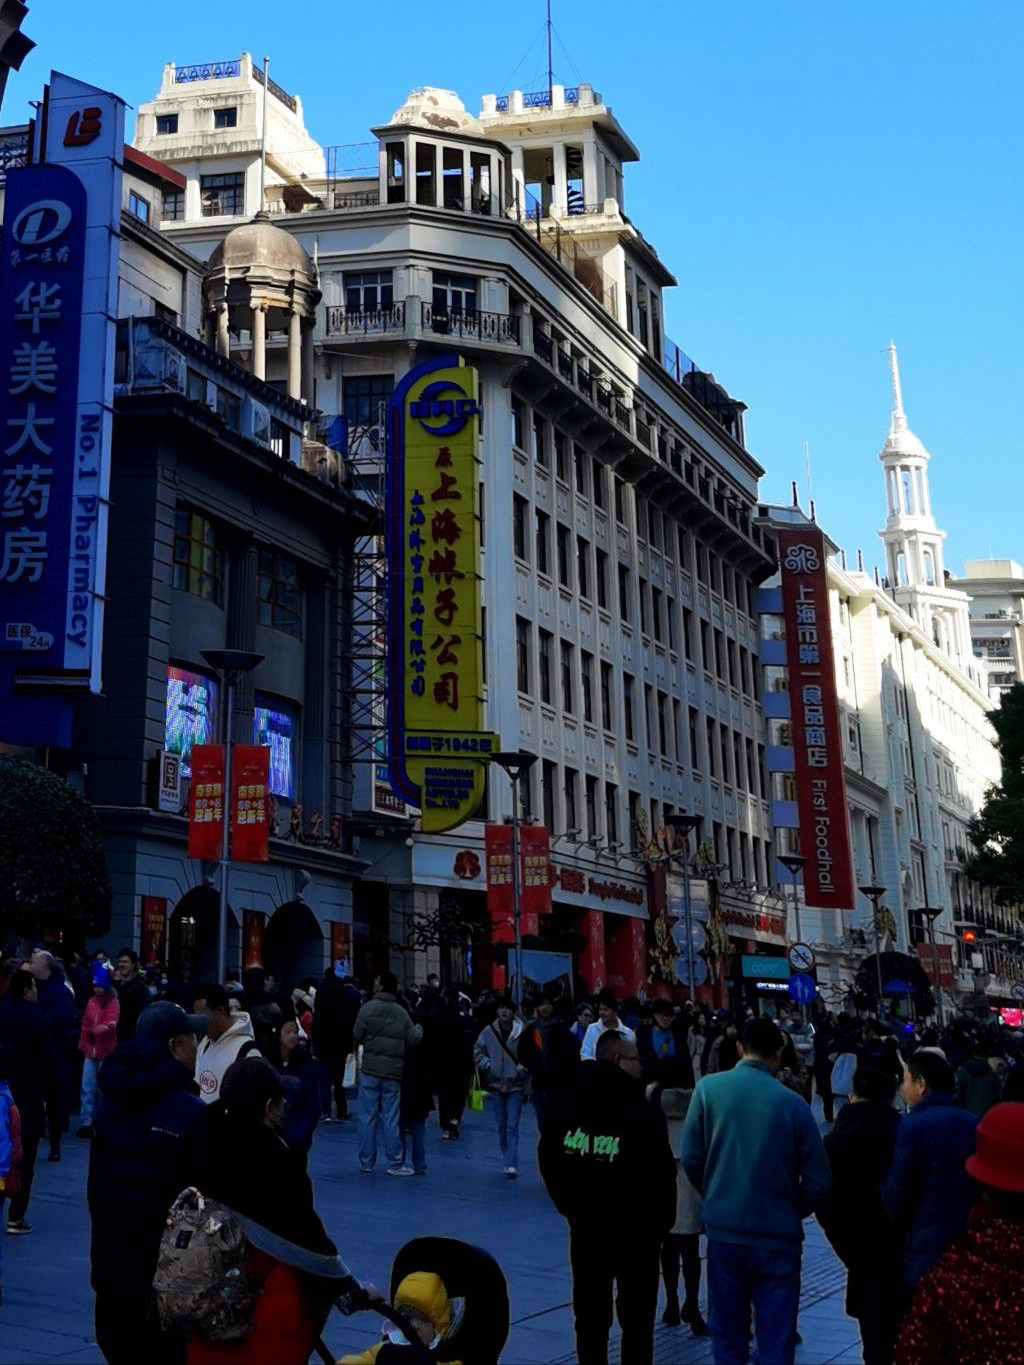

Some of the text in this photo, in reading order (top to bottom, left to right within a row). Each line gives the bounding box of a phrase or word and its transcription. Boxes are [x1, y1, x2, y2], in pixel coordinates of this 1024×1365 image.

[67, 414, 100, 648] No.1 Pharmacy
[7, 624, 31, 638] 医保
[796, 584, 827, 767] 上海市第一食品商店
[812, 779, 832, 894] First Foodhall
